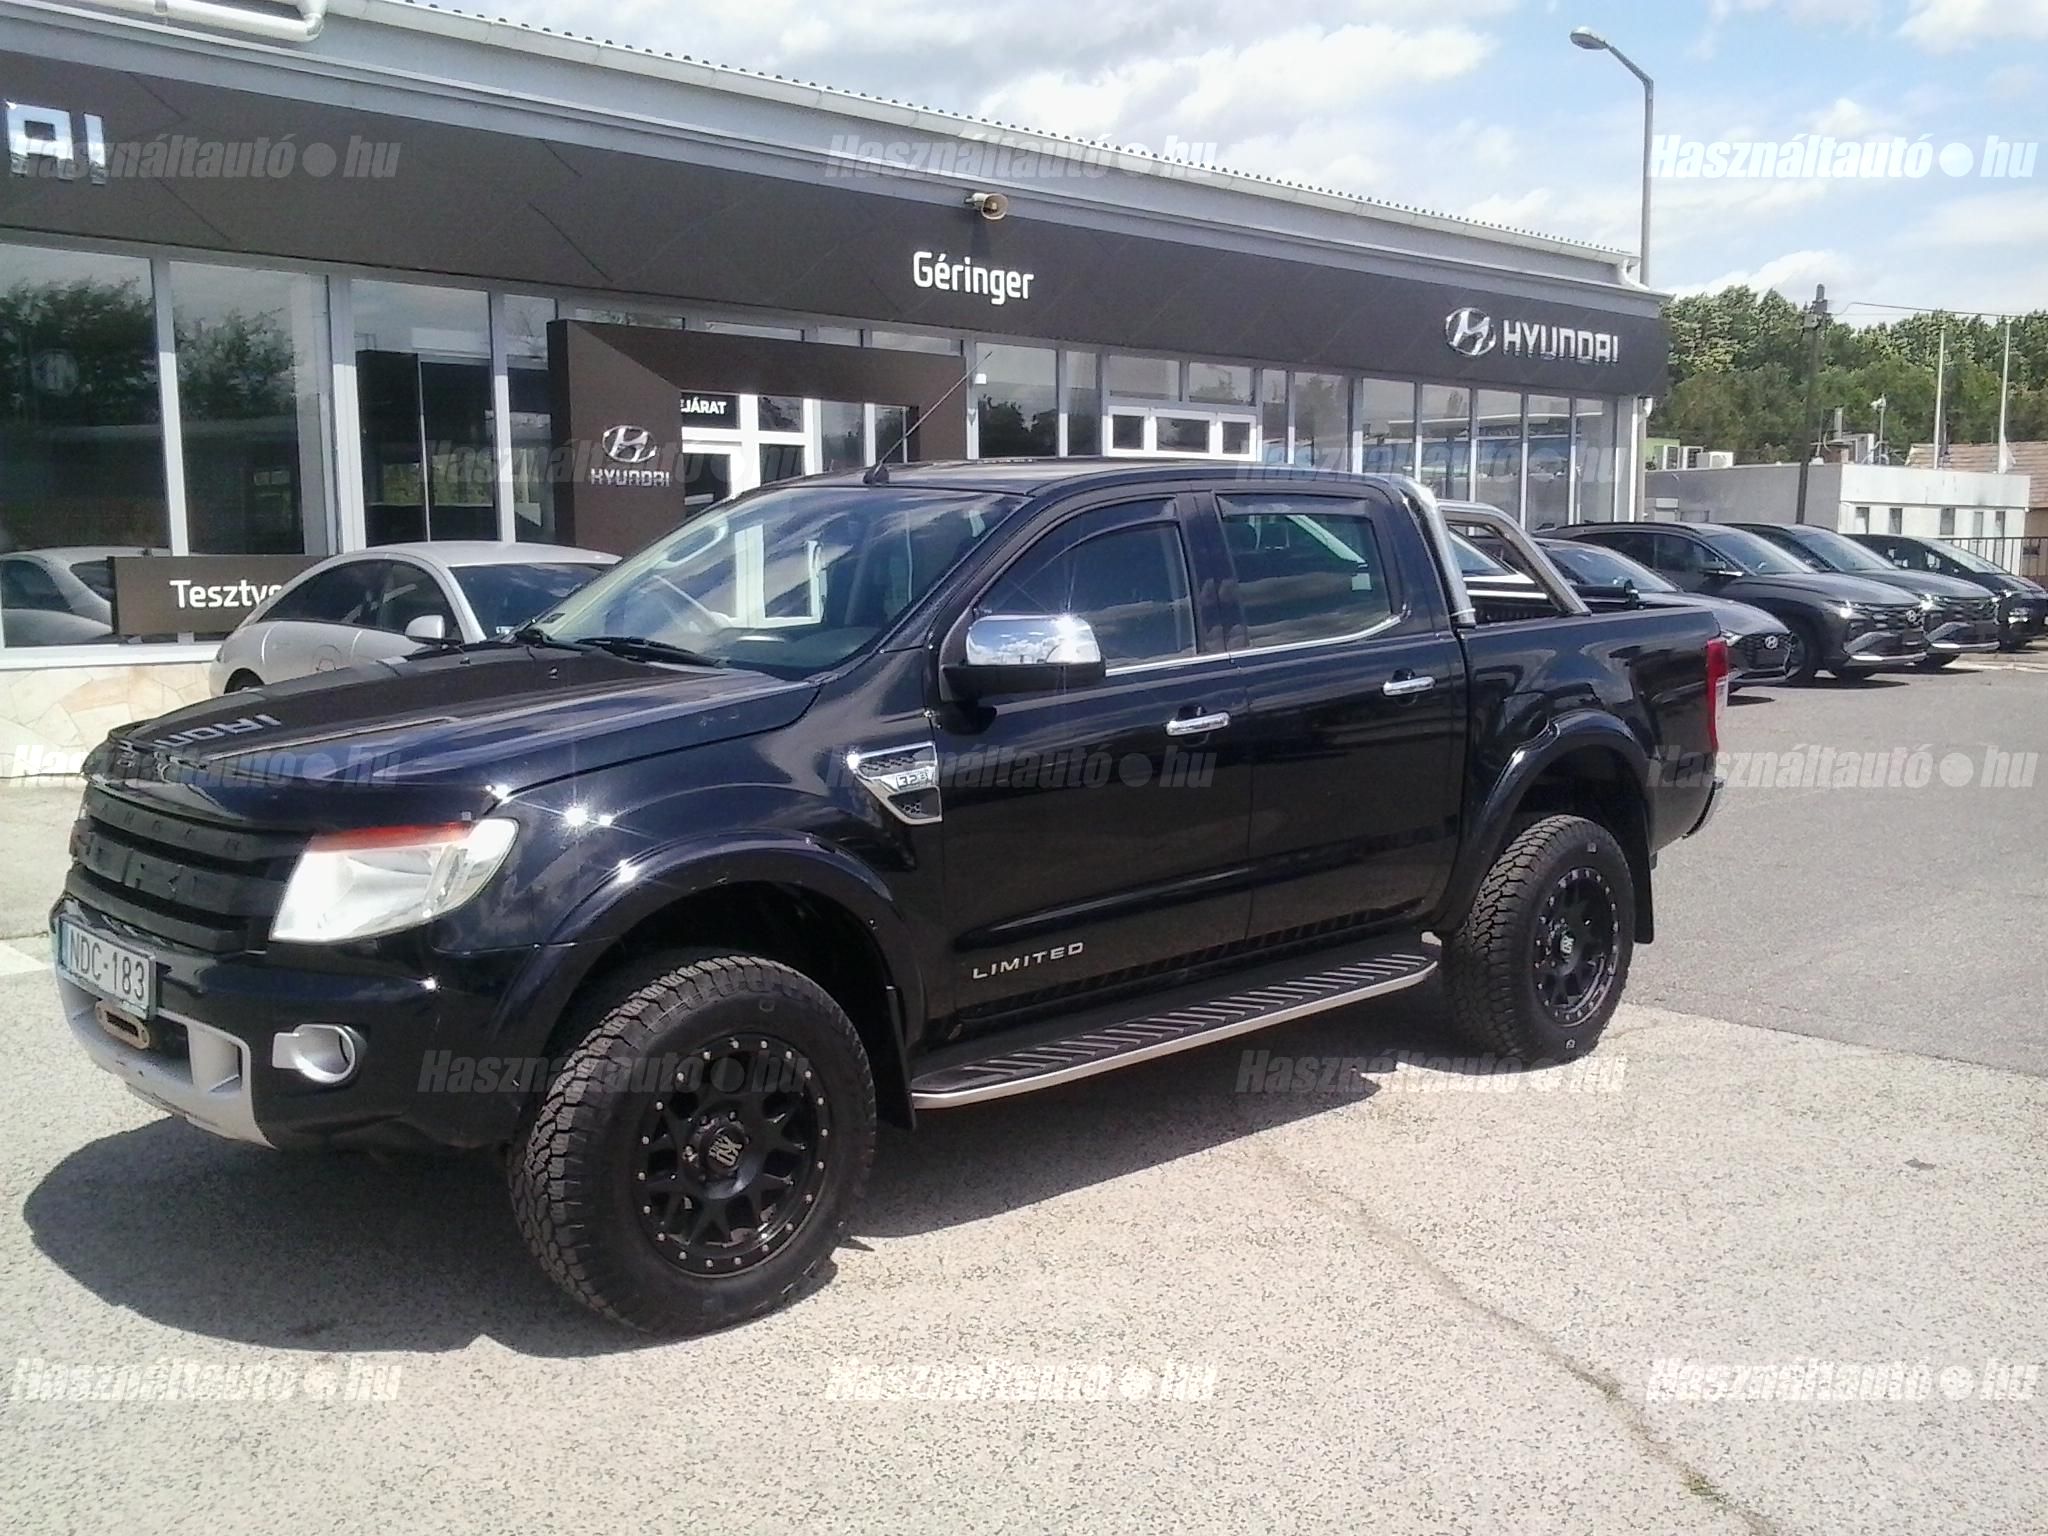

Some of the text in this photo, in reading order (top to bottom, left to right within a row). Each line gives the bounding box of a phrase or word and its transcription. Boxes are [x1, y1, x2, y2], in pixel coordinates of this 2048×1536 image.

[913, 251, 1035, 305] Géringer
[1503, 320, 1619, 365] HYUNDAI
[591, 468, 670, 488] HYUNDAI
[71, 929, 145, 1001] NDC-183
[972, 942, 1084, 979] LIMITED
